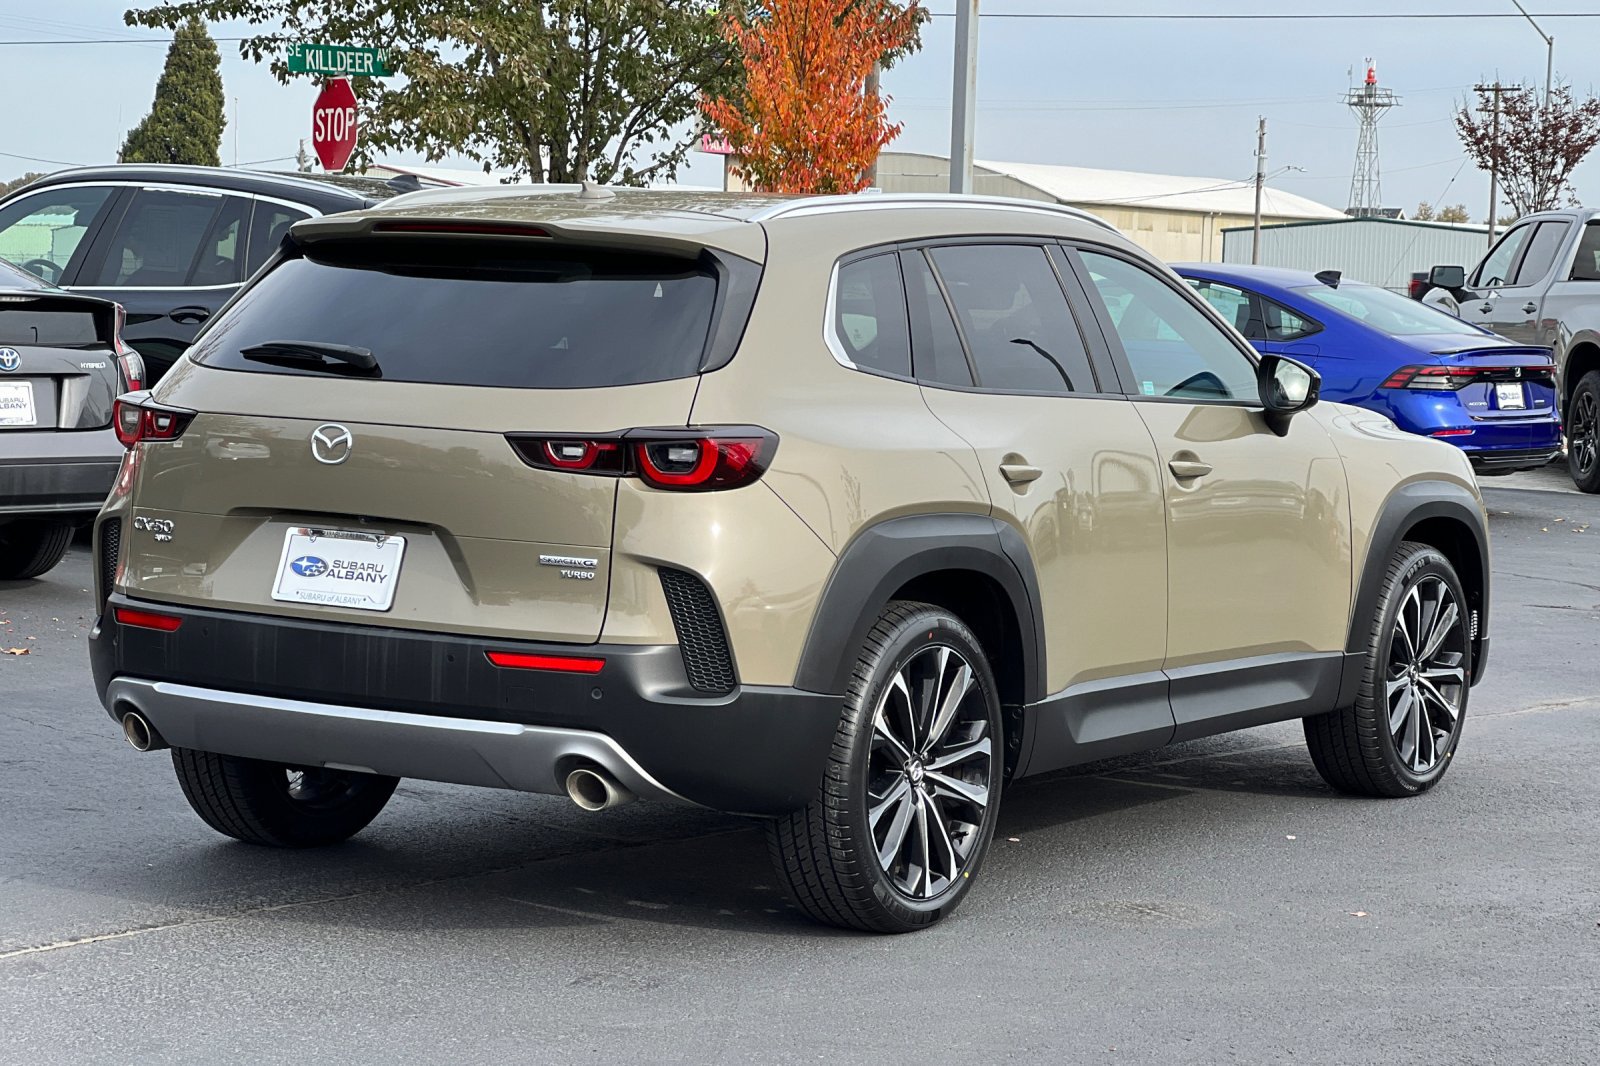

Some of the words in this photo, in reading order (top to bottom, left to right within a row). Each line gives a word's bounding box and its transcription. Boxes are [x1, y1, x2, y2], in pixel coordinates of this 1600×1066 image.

[288, 43, 302, 57] SE
[306, 49, 373, 72] KILLDEER
[315, 107, 355, 142] STOP
[134, 516, 174, 533] CX-50
[333, 560, 384, 573] SUBARU
[326, 569, 387, 584] ALBANY
[560, 569, 595, 580] TURBO
[299, 592, 326, 602] SUBARU
[327, 594, 335, 603] of
[336, 595, 362, 606] ALBANY
